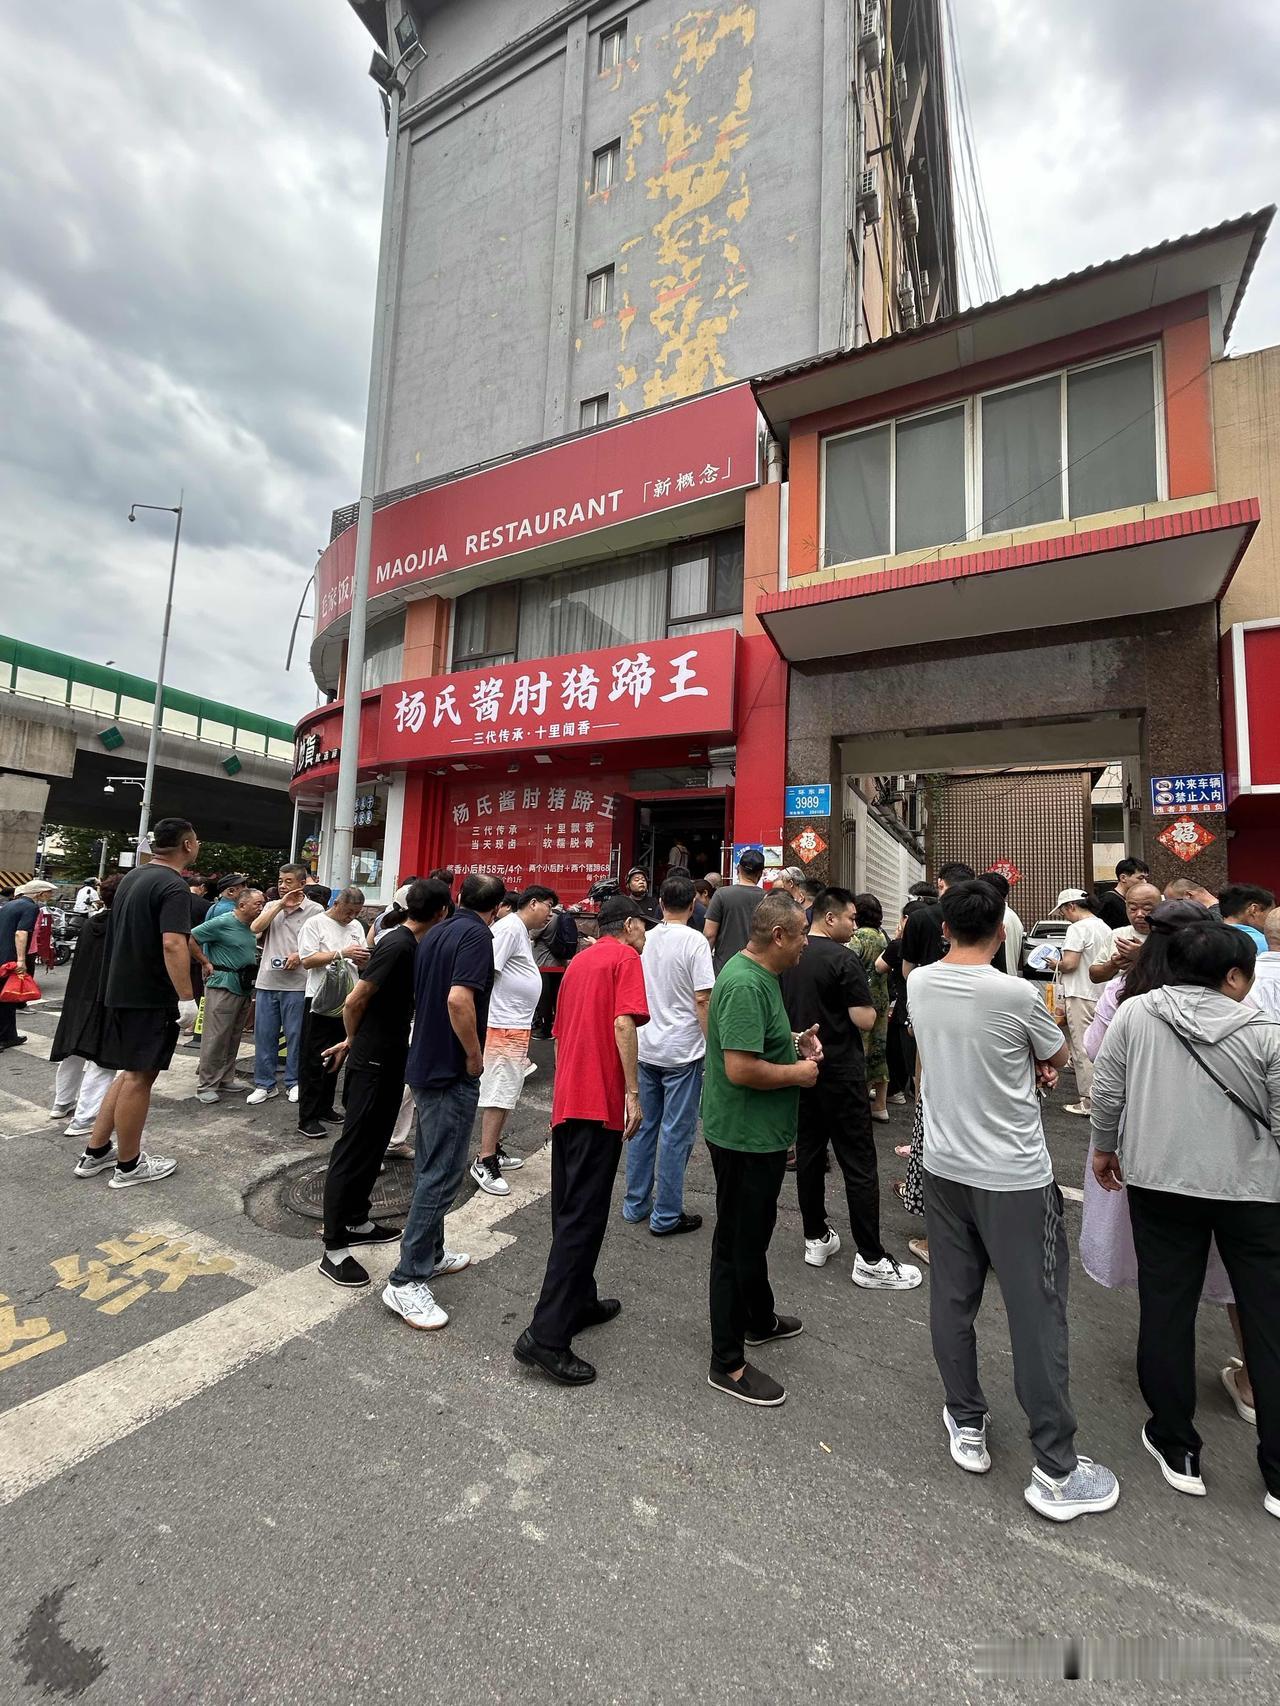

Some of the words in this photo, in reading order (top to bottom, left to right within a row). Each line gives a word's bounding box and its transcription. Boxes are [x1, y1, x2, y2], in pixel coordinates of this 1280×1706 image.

[376, 544, 448, 584] MAOJIA
[465, 489, 623, 555] RESTAURANT
[393, 650, 708, 734] 杨氏酱肘猪蹄王
[1174, 777, 1221, 791] 外来车辆
[795, 796, 819, 809] 3989
[1175, 790, 1221, 803] 禁止入内
[452, 787, 618, 826] 杨氏酱肘猪蹄王
[799, 832, 817, 849] 福
[1171, 822, 1198, 844] 福
